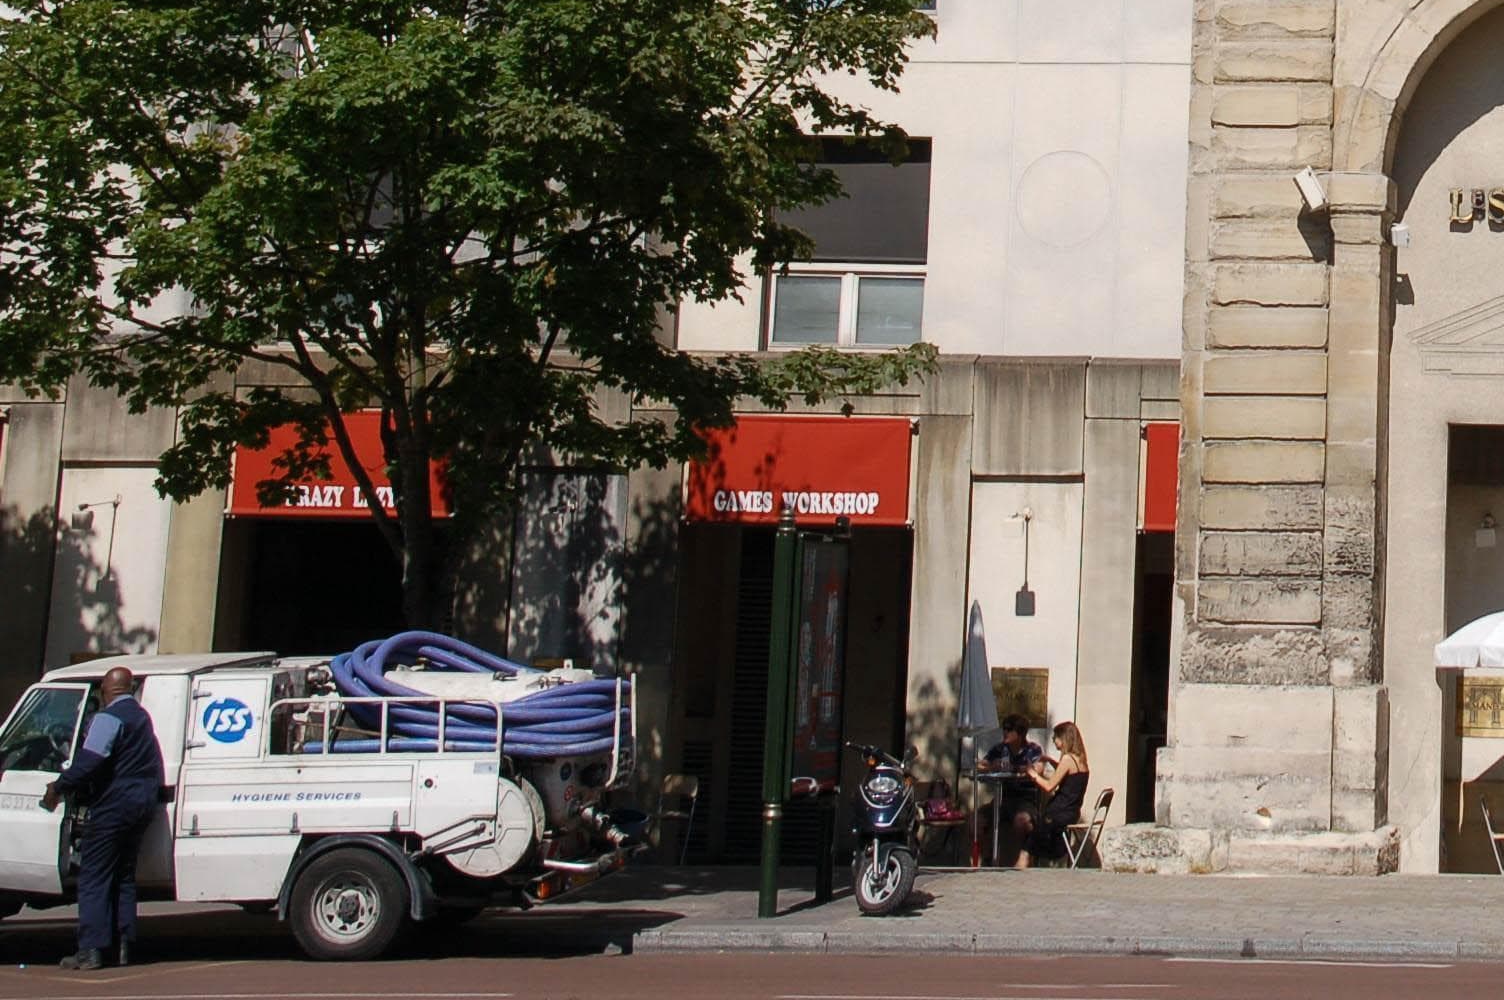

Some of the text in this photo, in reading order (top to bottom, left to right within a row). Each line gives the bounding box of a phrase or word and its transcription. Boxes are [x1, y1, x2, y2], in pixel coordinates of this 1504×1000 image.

[284, 485, 344, 507] RAZY
[714, 490, 879, 514] GAMES WORKSHOP
[231, 791, 362, 802] HYGIENE SERVICES
